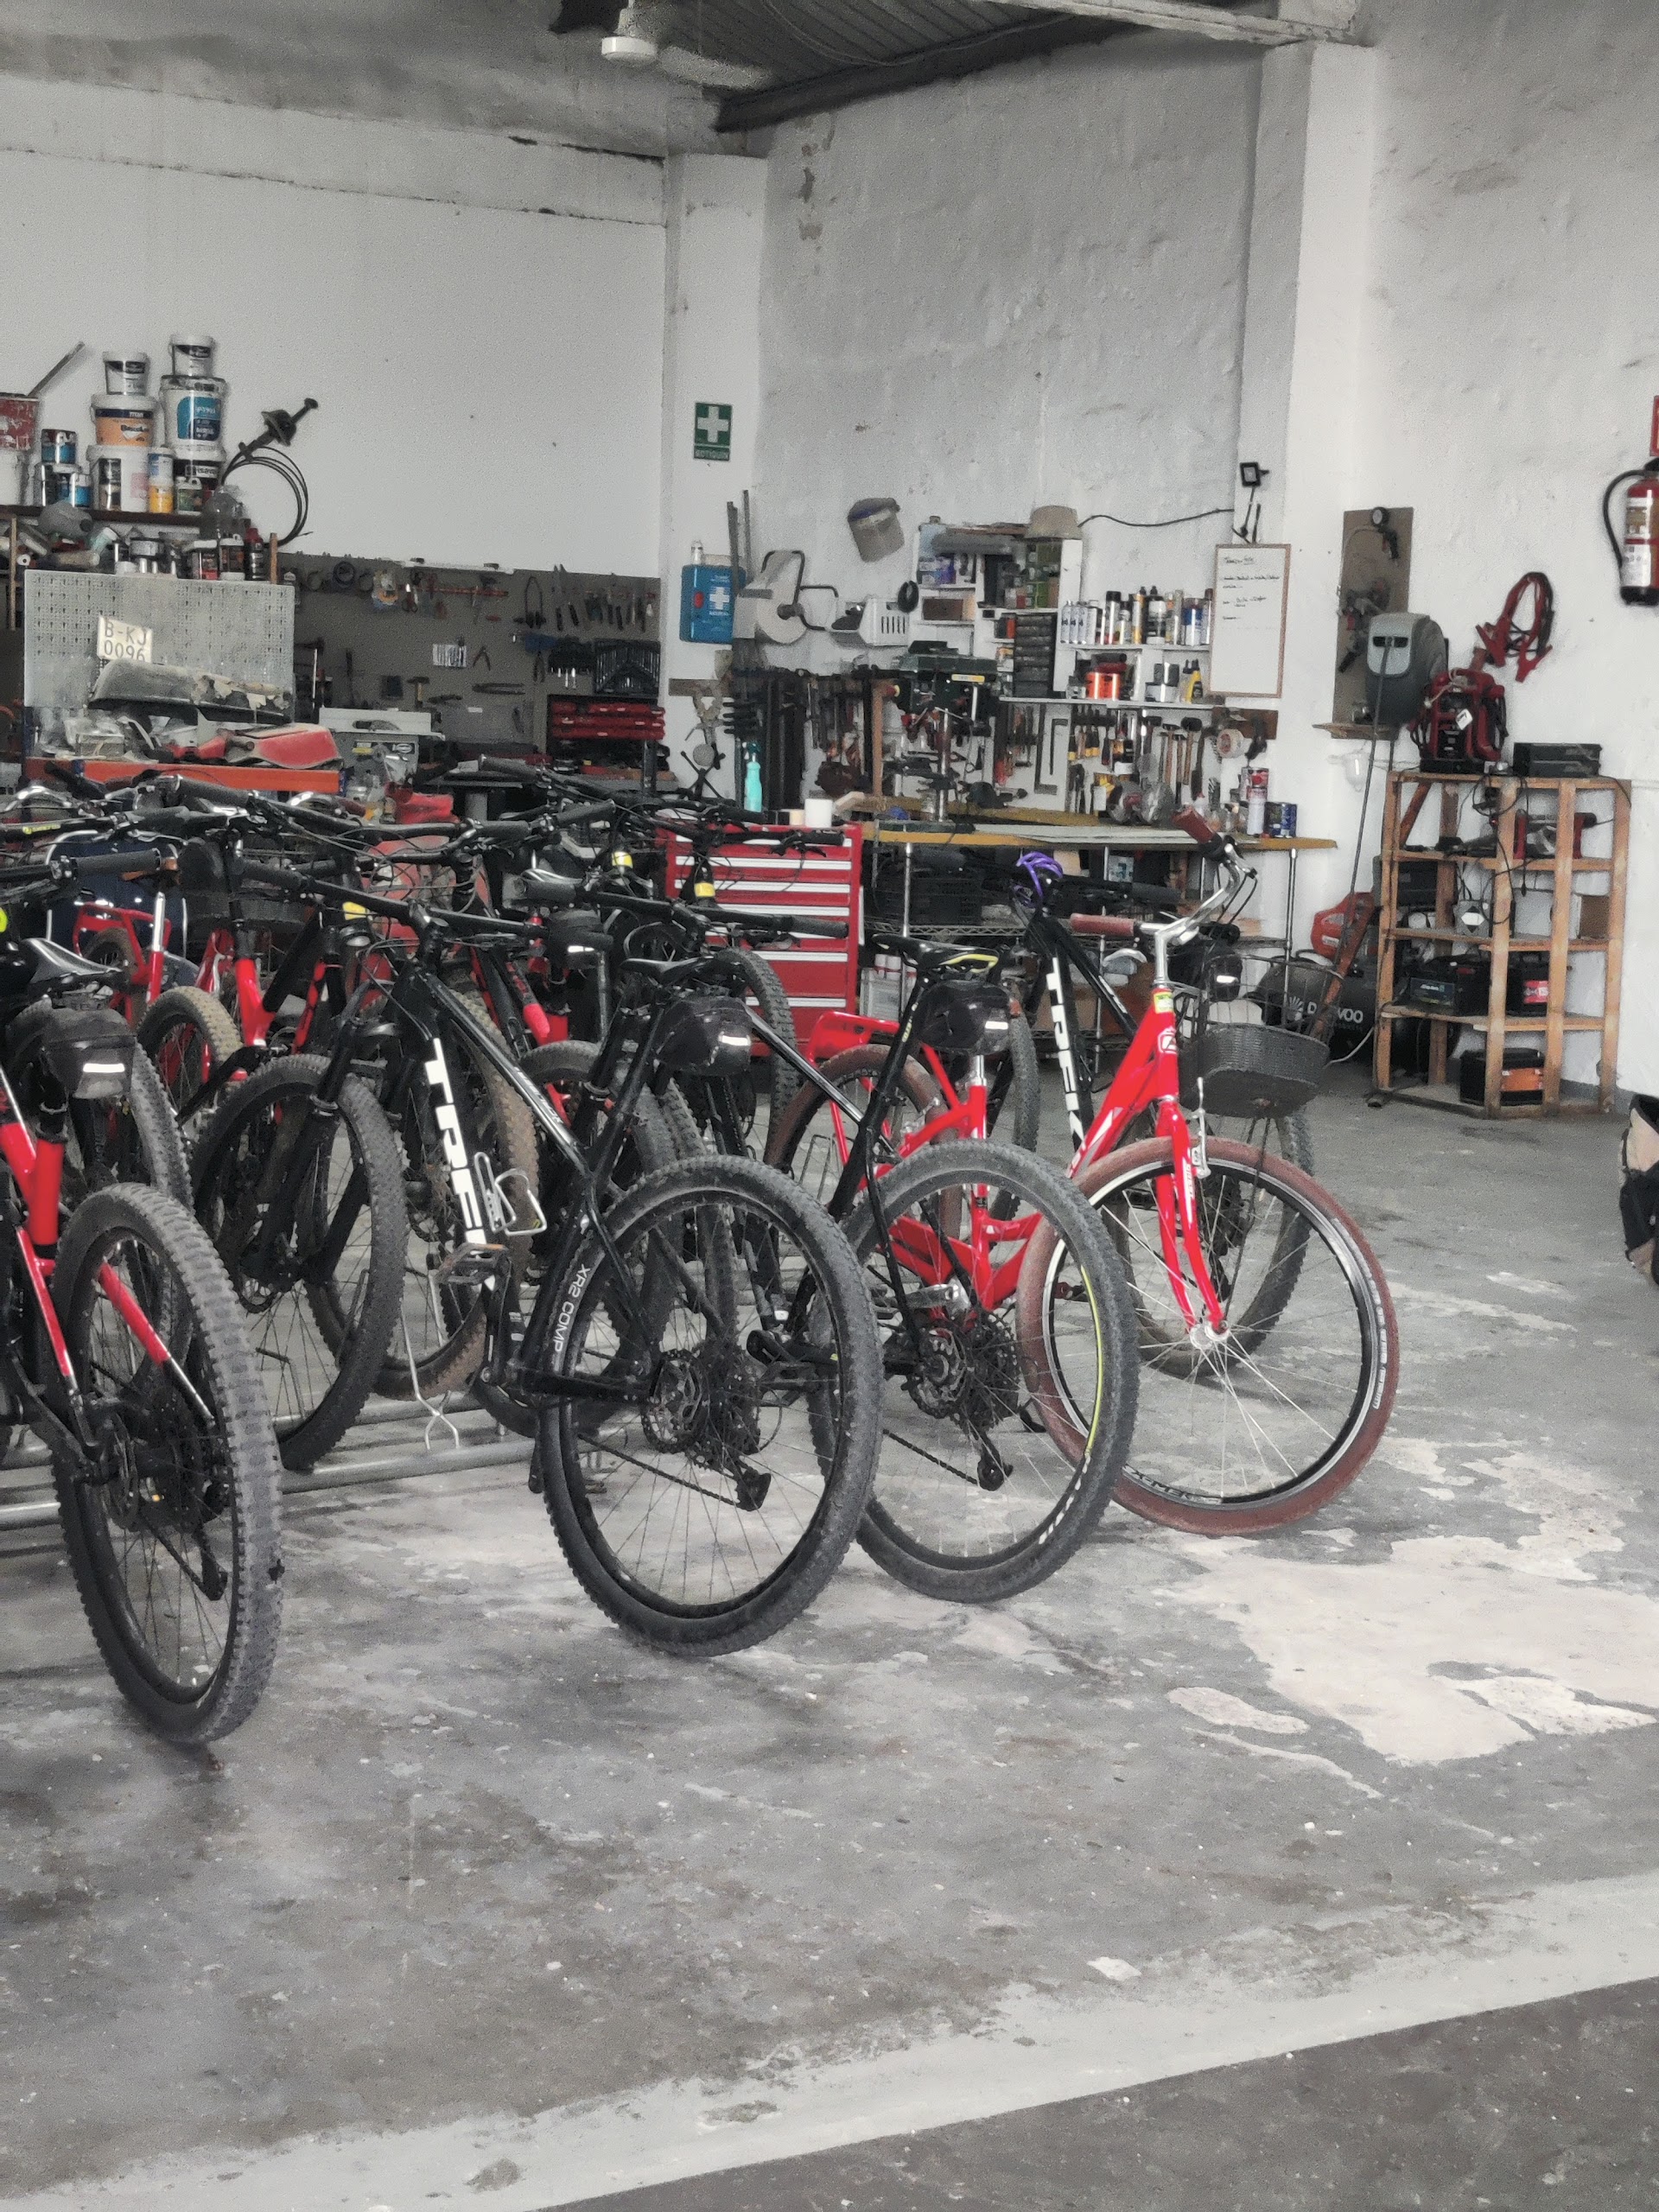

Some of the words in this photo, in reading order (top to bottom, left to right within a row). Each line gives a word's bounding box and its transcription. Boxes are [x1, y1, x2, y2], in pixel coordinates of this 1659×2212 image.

[105, 639, 146, 663] 0096
[1307, 1001, 1363, 1024] DWOO
[1046, 957, 1086, 1152] TREK
[568, 1263, 591, 1298] XR2
[553, 1300, 575, 1352] COMP
